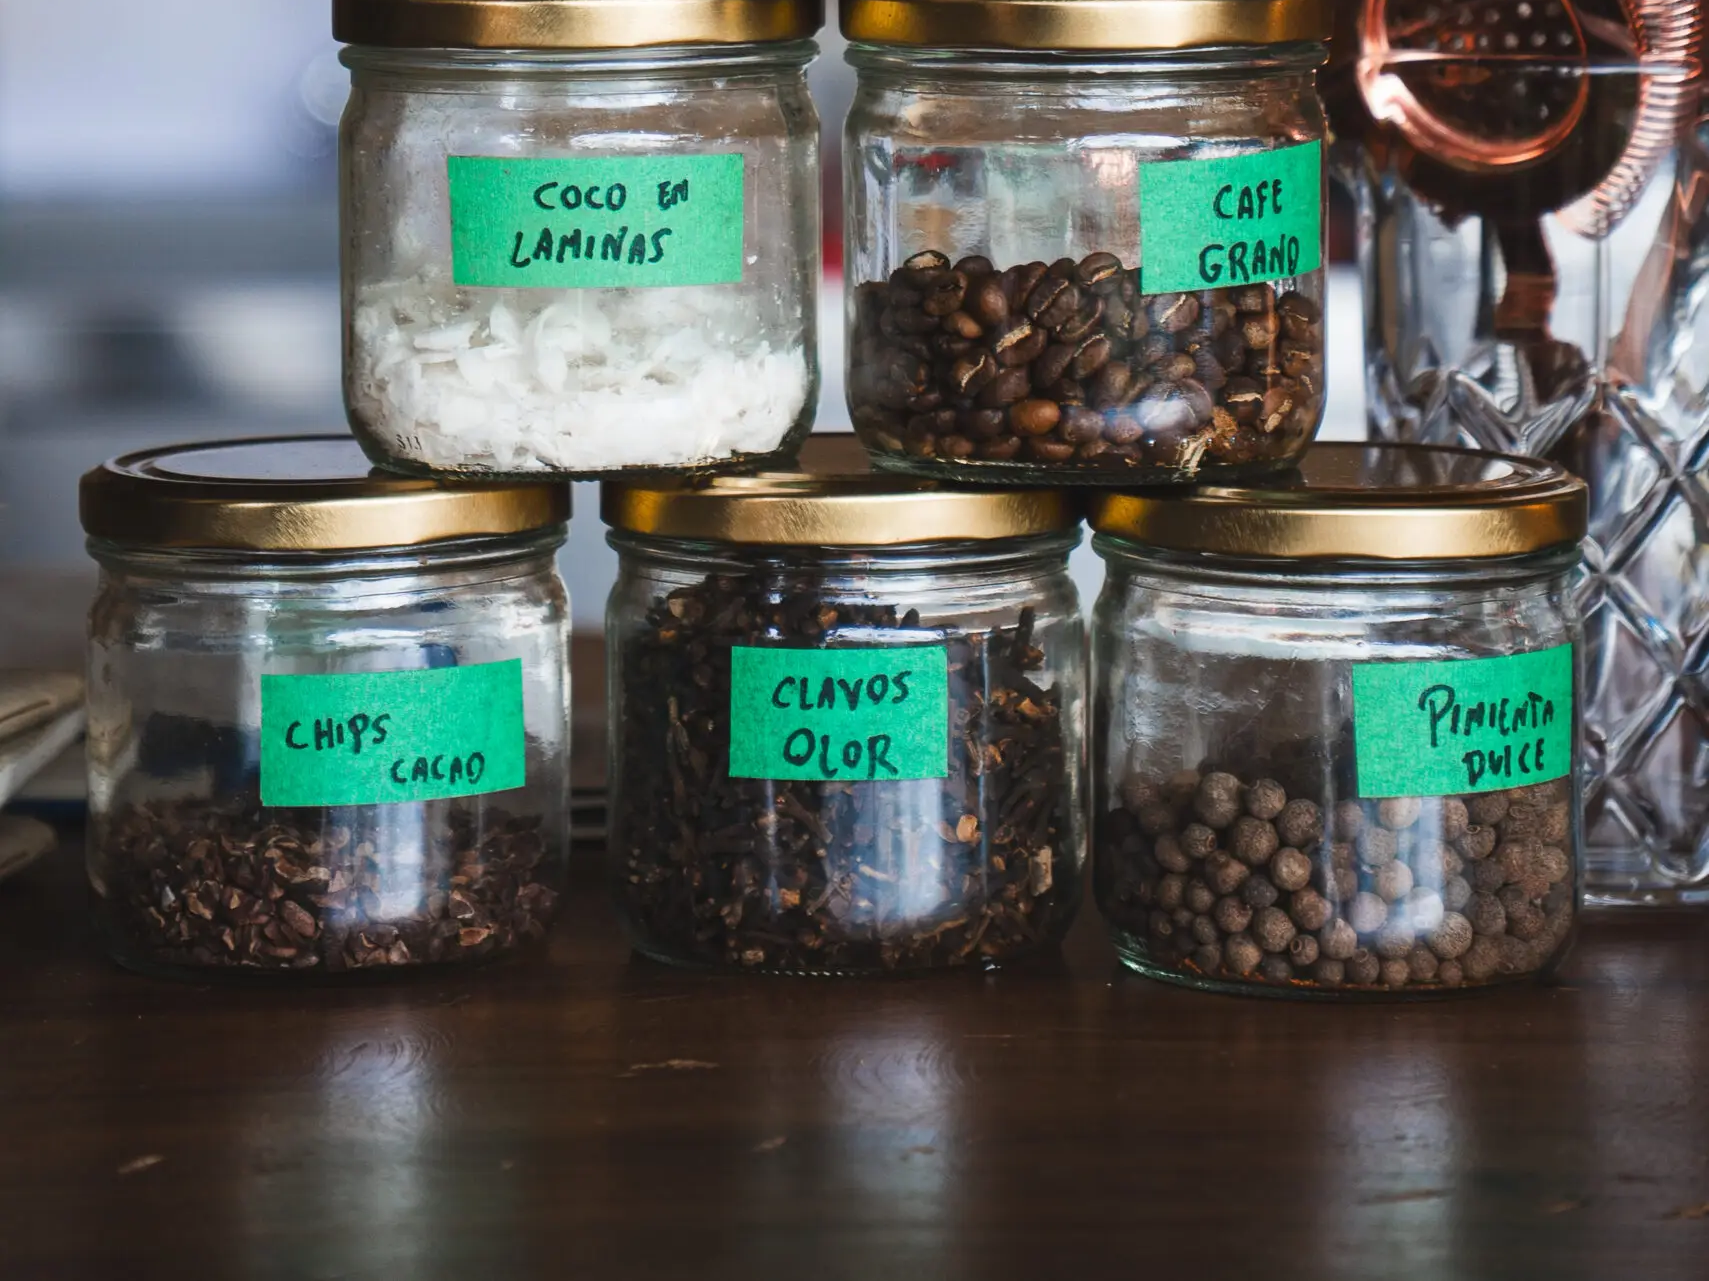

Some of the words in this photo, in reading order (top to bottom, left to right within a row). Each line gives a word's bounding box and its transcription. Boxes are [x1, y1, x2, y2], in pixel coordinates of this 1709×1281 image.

[533, 181, 627, 211] COCO
[657, 178, 690, 211] EN
[1212, 178, 1283, 220] CAFE
[511, 225, 673, 268] LAMINAS
[1199, 233, 1300, 283] GRANO
[771, 670, 913, 711] CLAVOS
[285, 713, 391, 755] CHIPS
[1418, 684, 1554, 748] PIMIENTA
[390, 751, 486, 785] CACAO
[783, 728, 899, 779] OLOR
